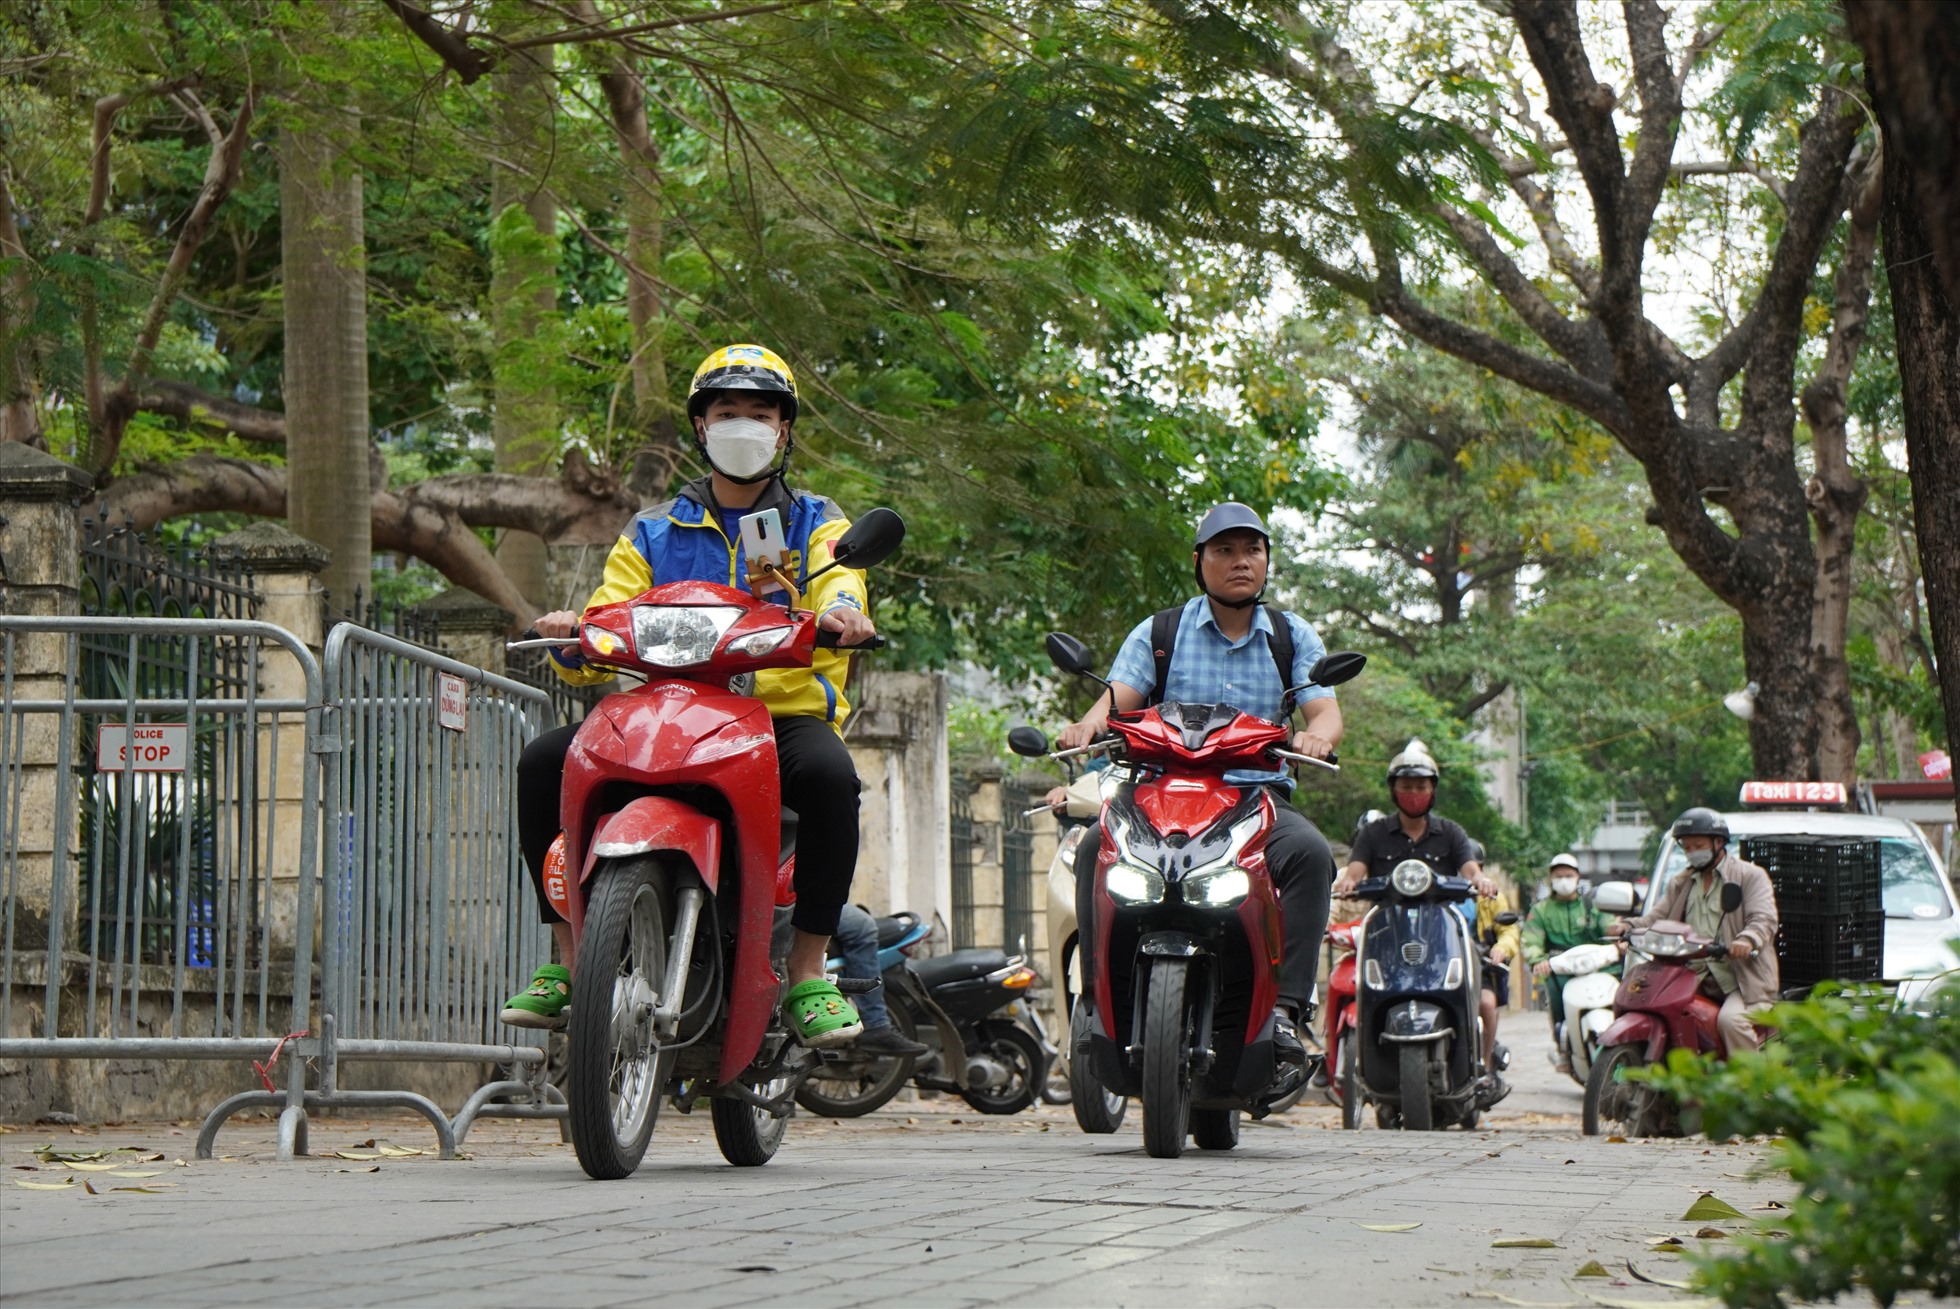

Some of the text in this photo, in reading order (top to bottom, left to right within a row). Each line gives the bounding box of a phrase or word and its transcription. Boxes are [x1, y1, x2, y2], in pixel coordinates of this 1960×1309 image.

[653, 683, 698, 695] HONDA
[133, 730, 164, 739] OLICE
[119, 745, 171, 762] STOP
[1749, 782, 1837, 801] Taxi 123
[553, 847, 566, 876] Foo
